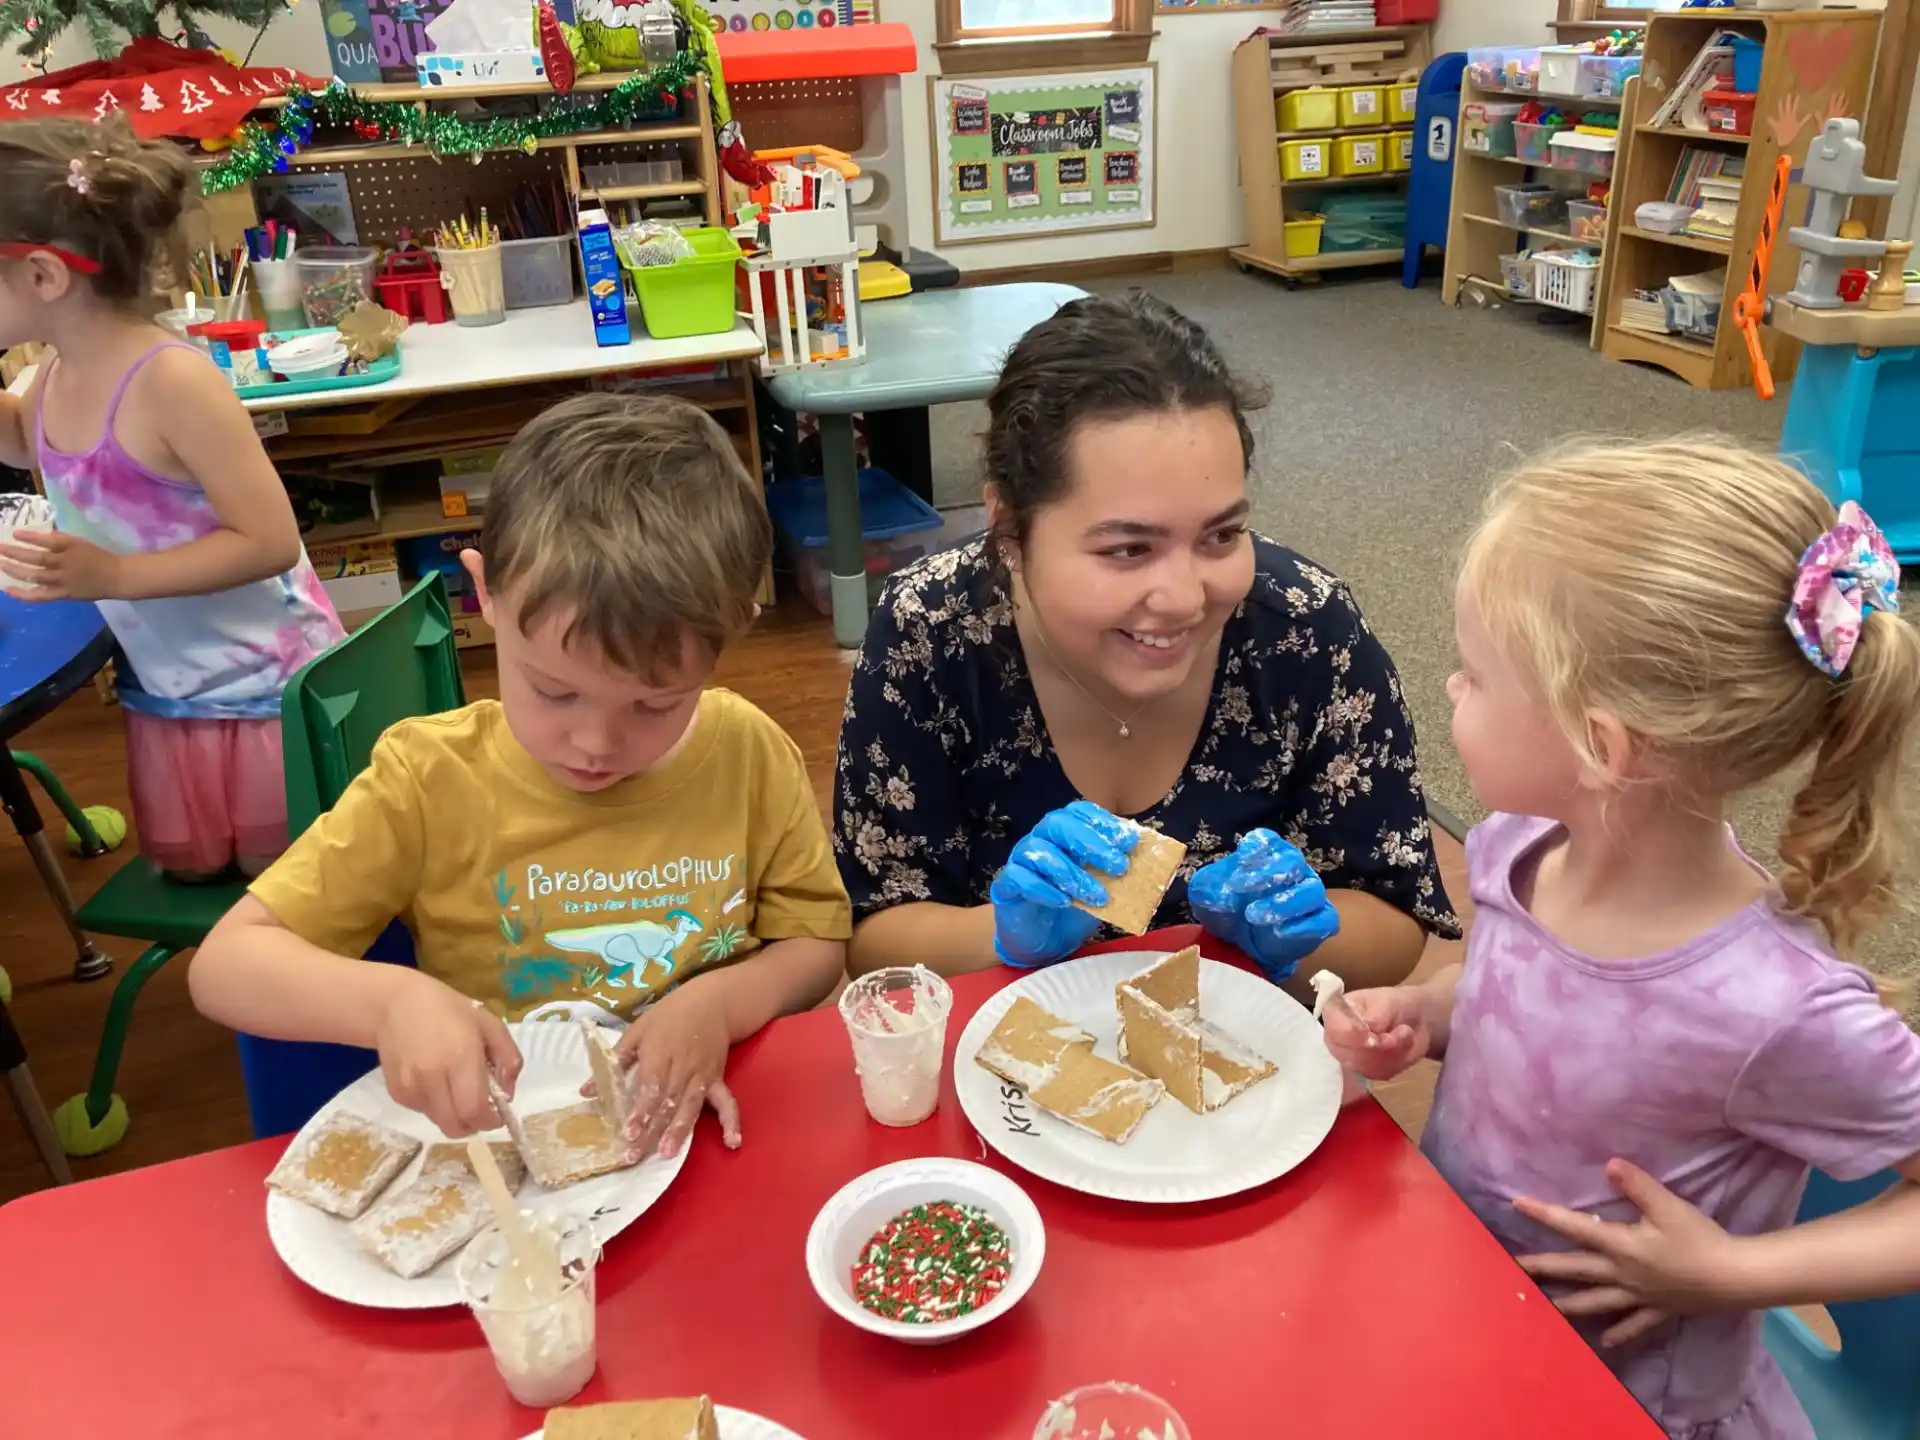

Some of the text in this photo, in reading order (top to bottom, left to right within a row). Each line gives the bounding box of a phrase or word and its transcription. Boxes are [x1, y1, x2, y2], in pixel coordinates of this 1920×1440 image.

[371, 13, 437, 68] BU
[473, 61, 499, 77] Livi
[999, 125, 1065, 146] Classroom
[1066, 119, 1094, 142] Jobs
